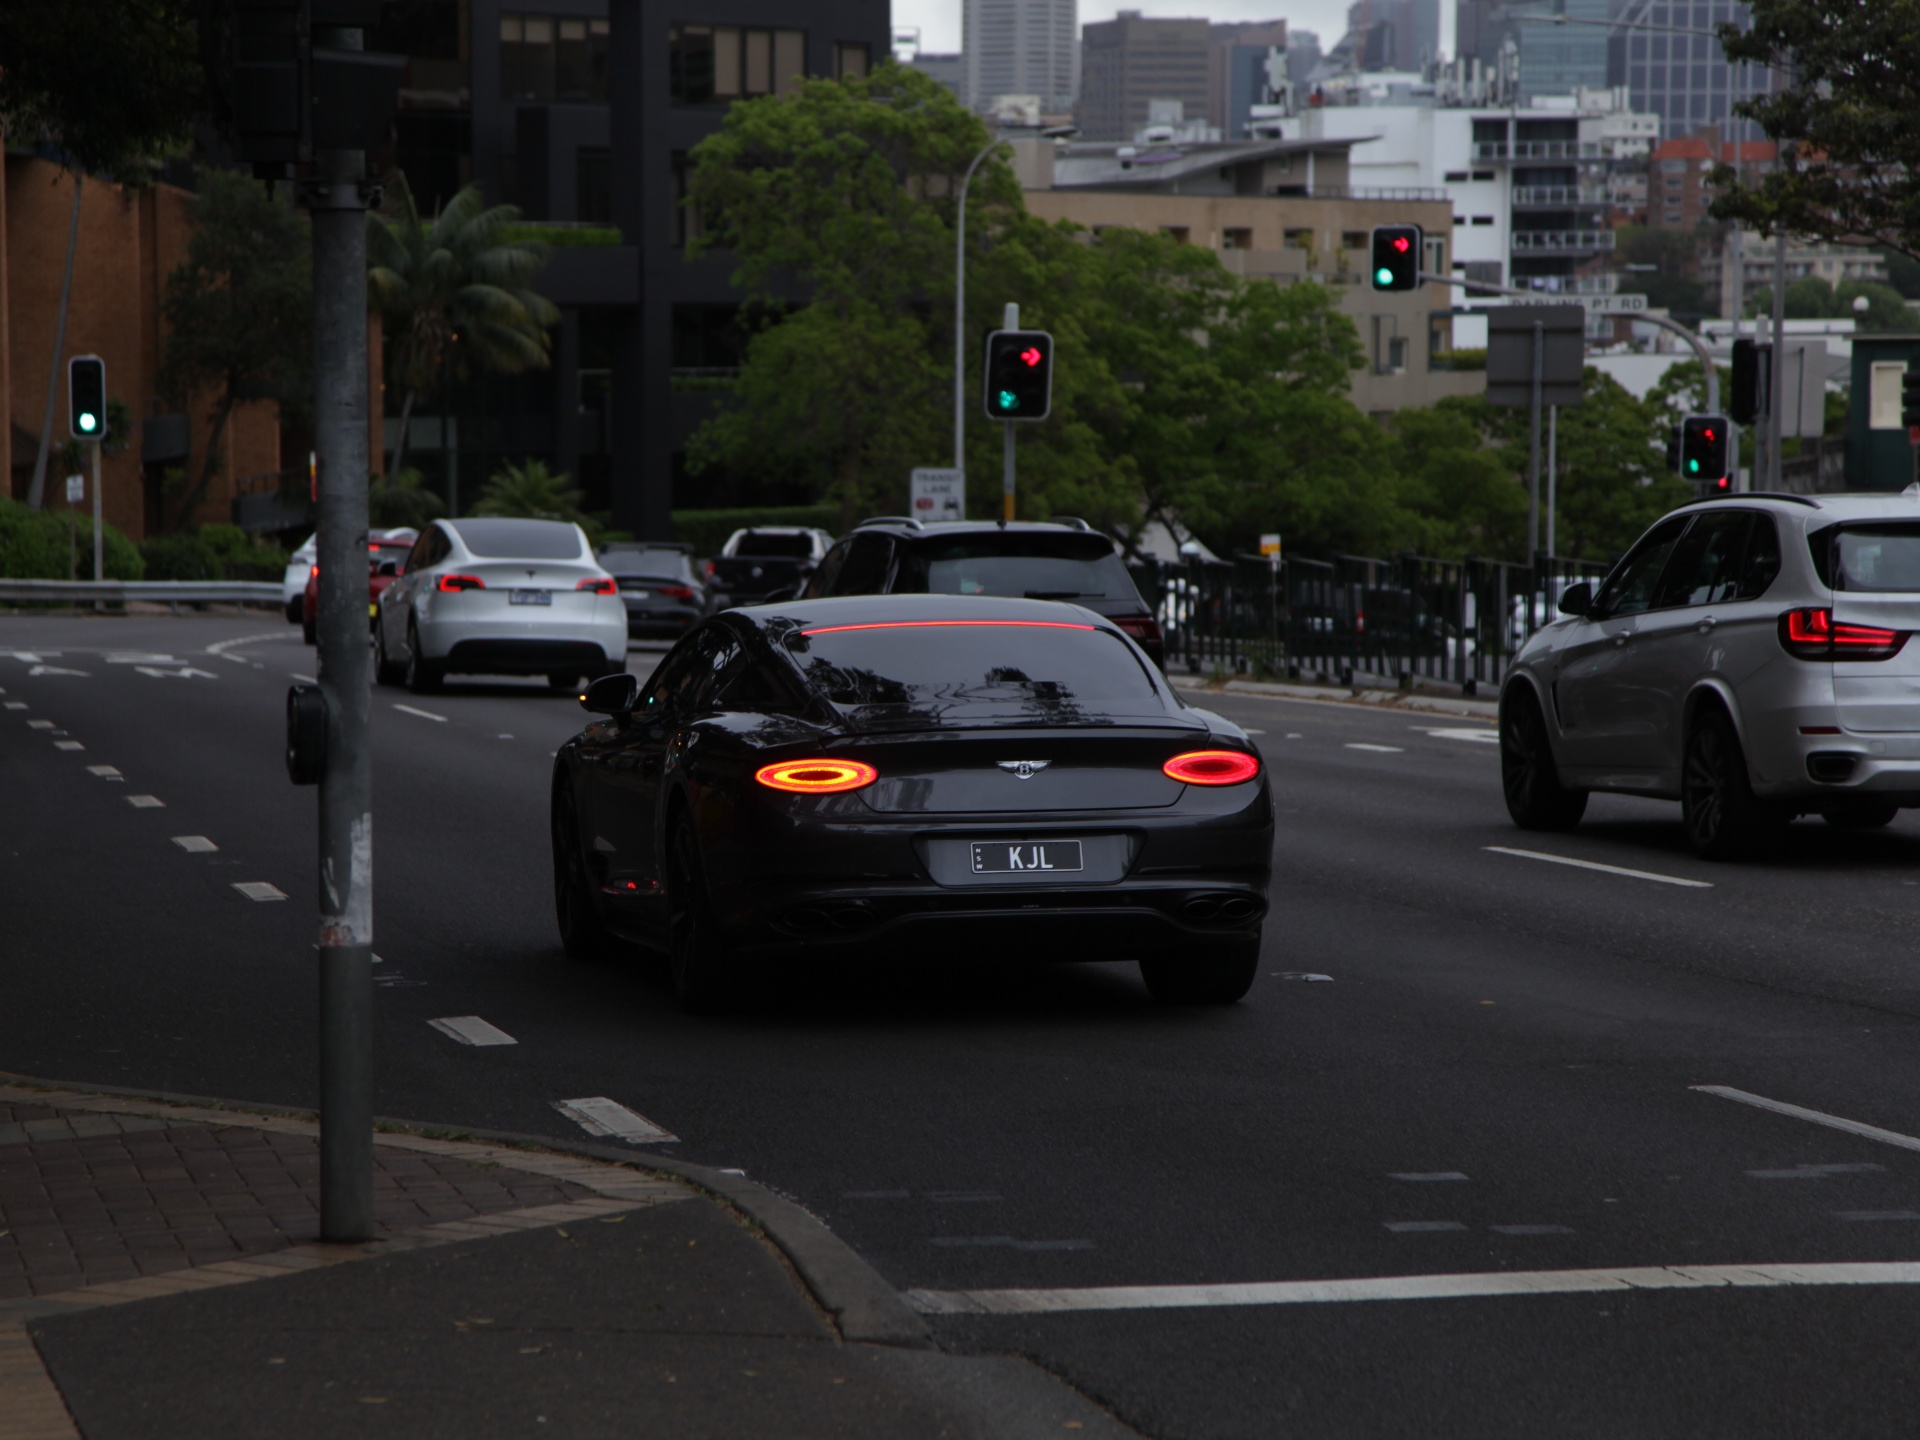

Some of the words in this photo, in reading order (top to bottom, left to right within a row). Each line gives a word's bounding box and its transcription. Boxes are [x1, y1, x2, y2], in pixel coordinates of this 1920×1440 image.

[1592, 298, 1610, 310] PT
[1621, 298, 1643, 310] RD
[917, 473, 960, 482] TRANSIT
[923, 484, 951, 493] LANE
[1009, 846, 1053, 869] KJL
